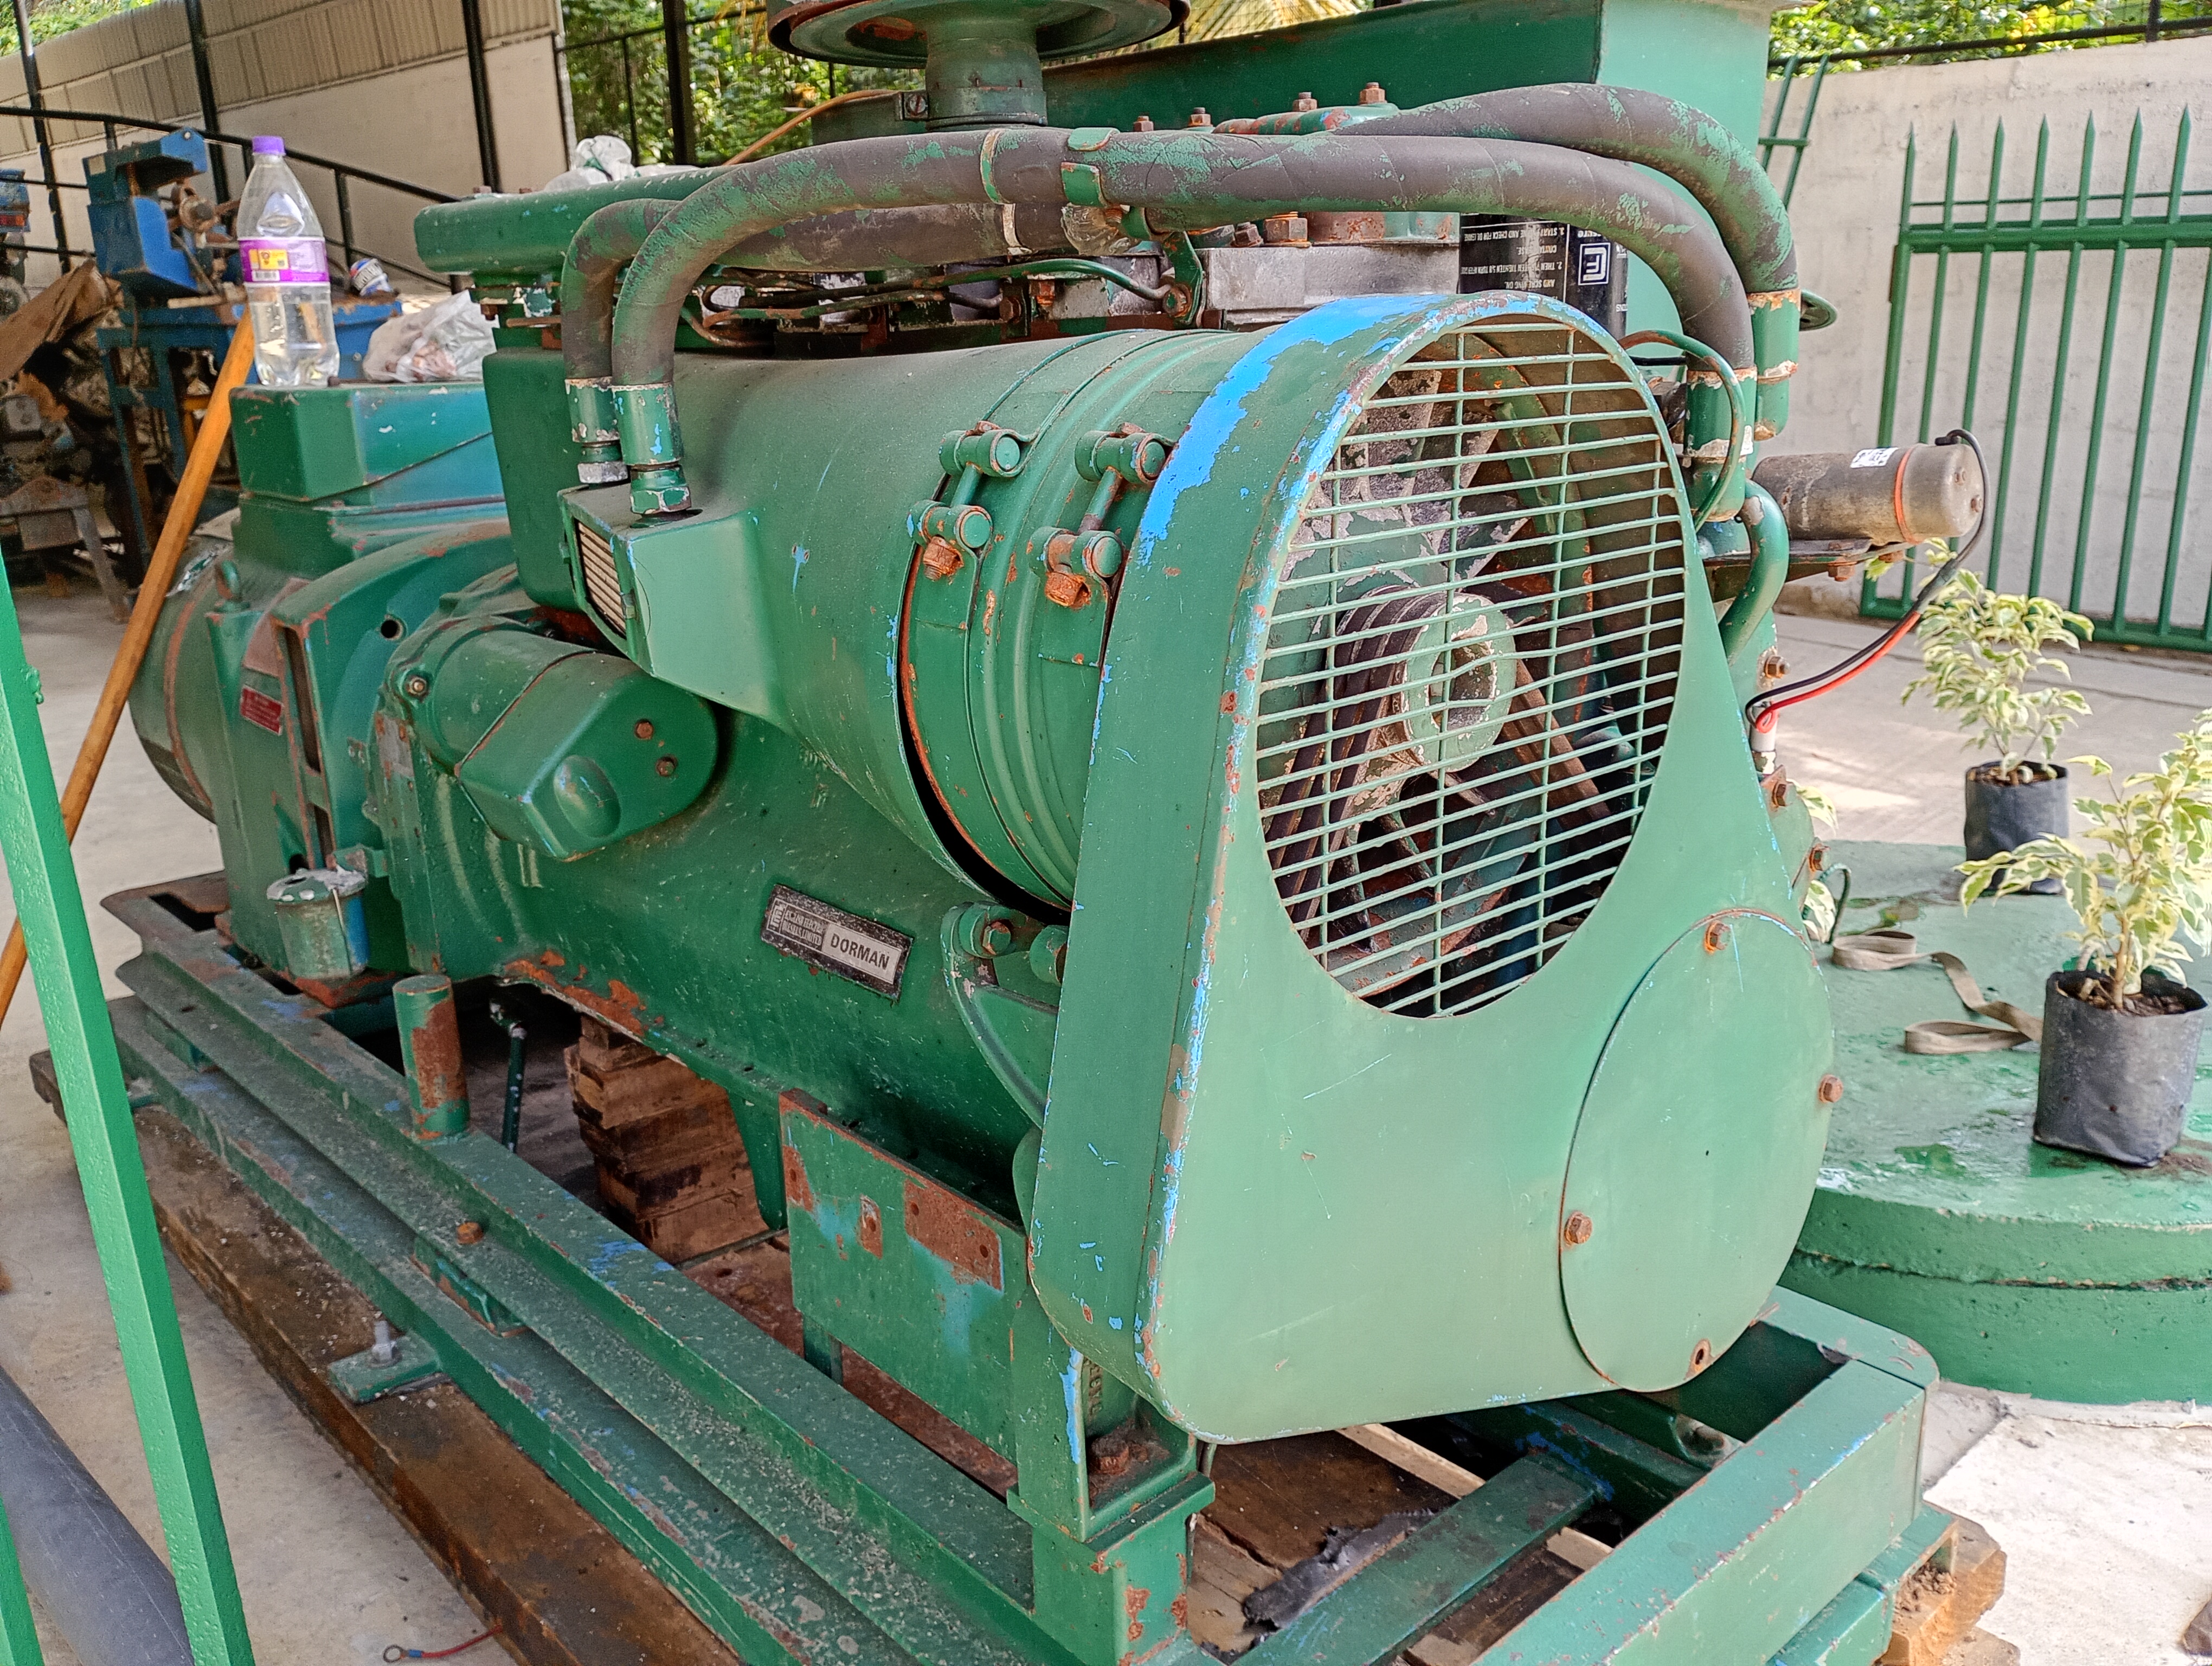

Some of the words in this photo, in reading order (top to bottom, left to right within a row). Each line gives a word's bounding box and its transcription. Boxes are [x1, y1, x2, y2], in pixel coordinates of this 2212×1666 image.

[1492, 230, 1508, 240] CHECK
[1508, 229, 1520, 239] AND
[1540, 227, 1558, 236] START
[1540, 262, 1555, 271] THEN
[1557, 261, 1562, 270] 2.
[1543, 279, 1555, 287] AND
[831, 933, 890, 971] DORMAN
